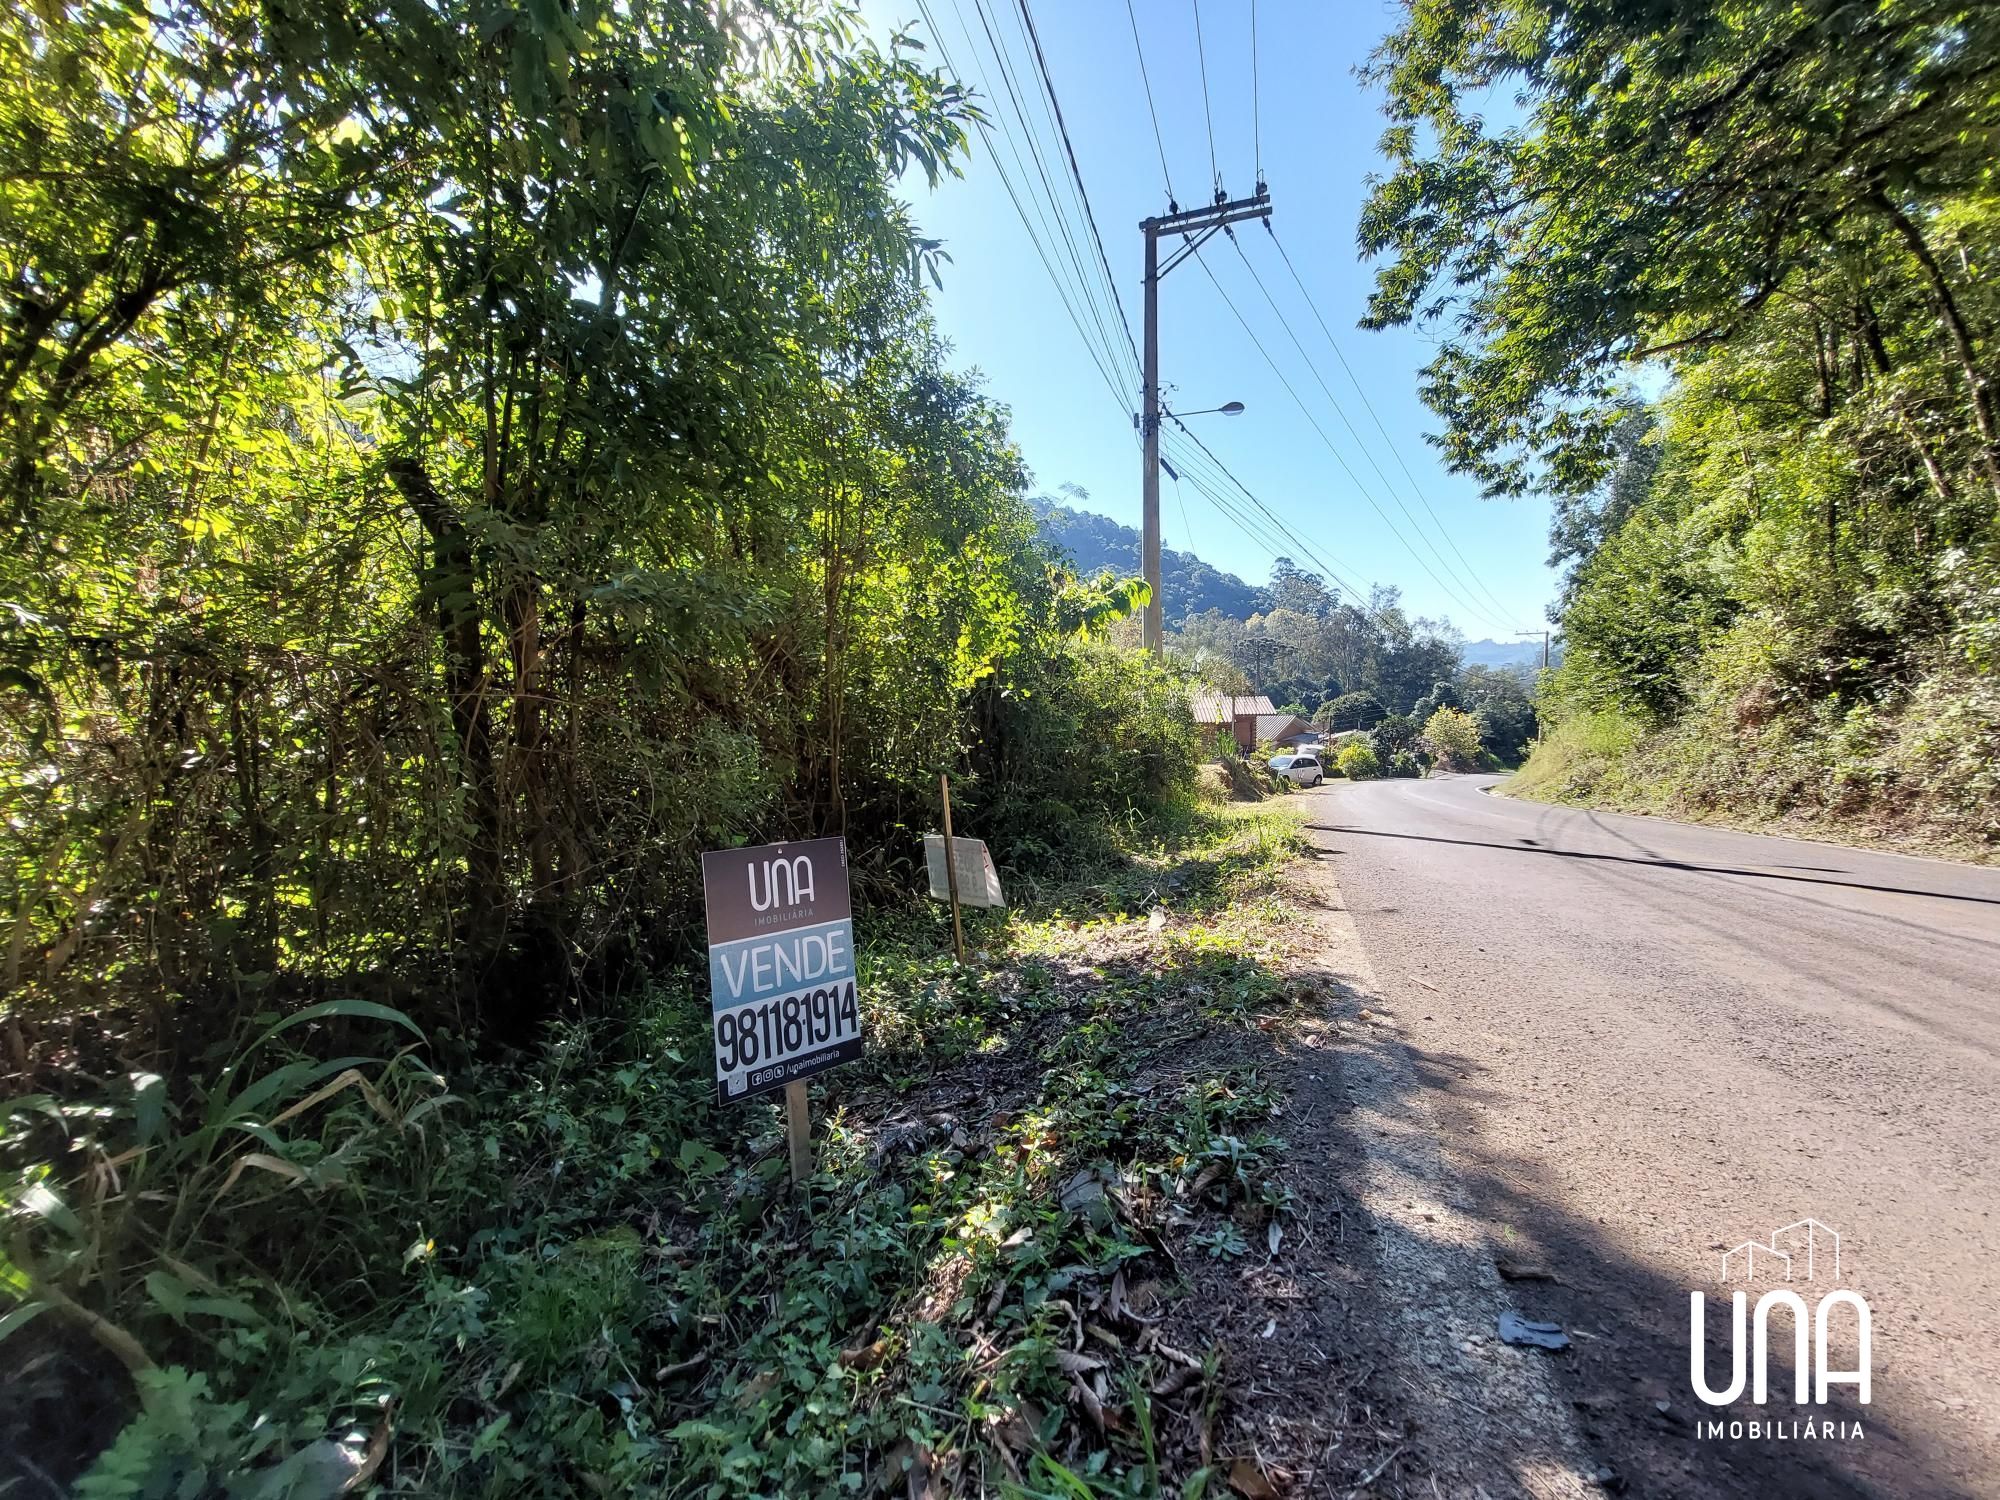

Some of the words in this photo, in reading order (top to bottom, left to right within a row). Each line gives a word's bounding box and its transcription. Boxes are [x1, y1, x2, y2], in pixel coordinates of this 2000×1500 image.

[748, 855, 815, 912] UNA
[754, 908, 814, 926] IMOBILIÁRIA
[720, 929, 847, 998] VENDE
